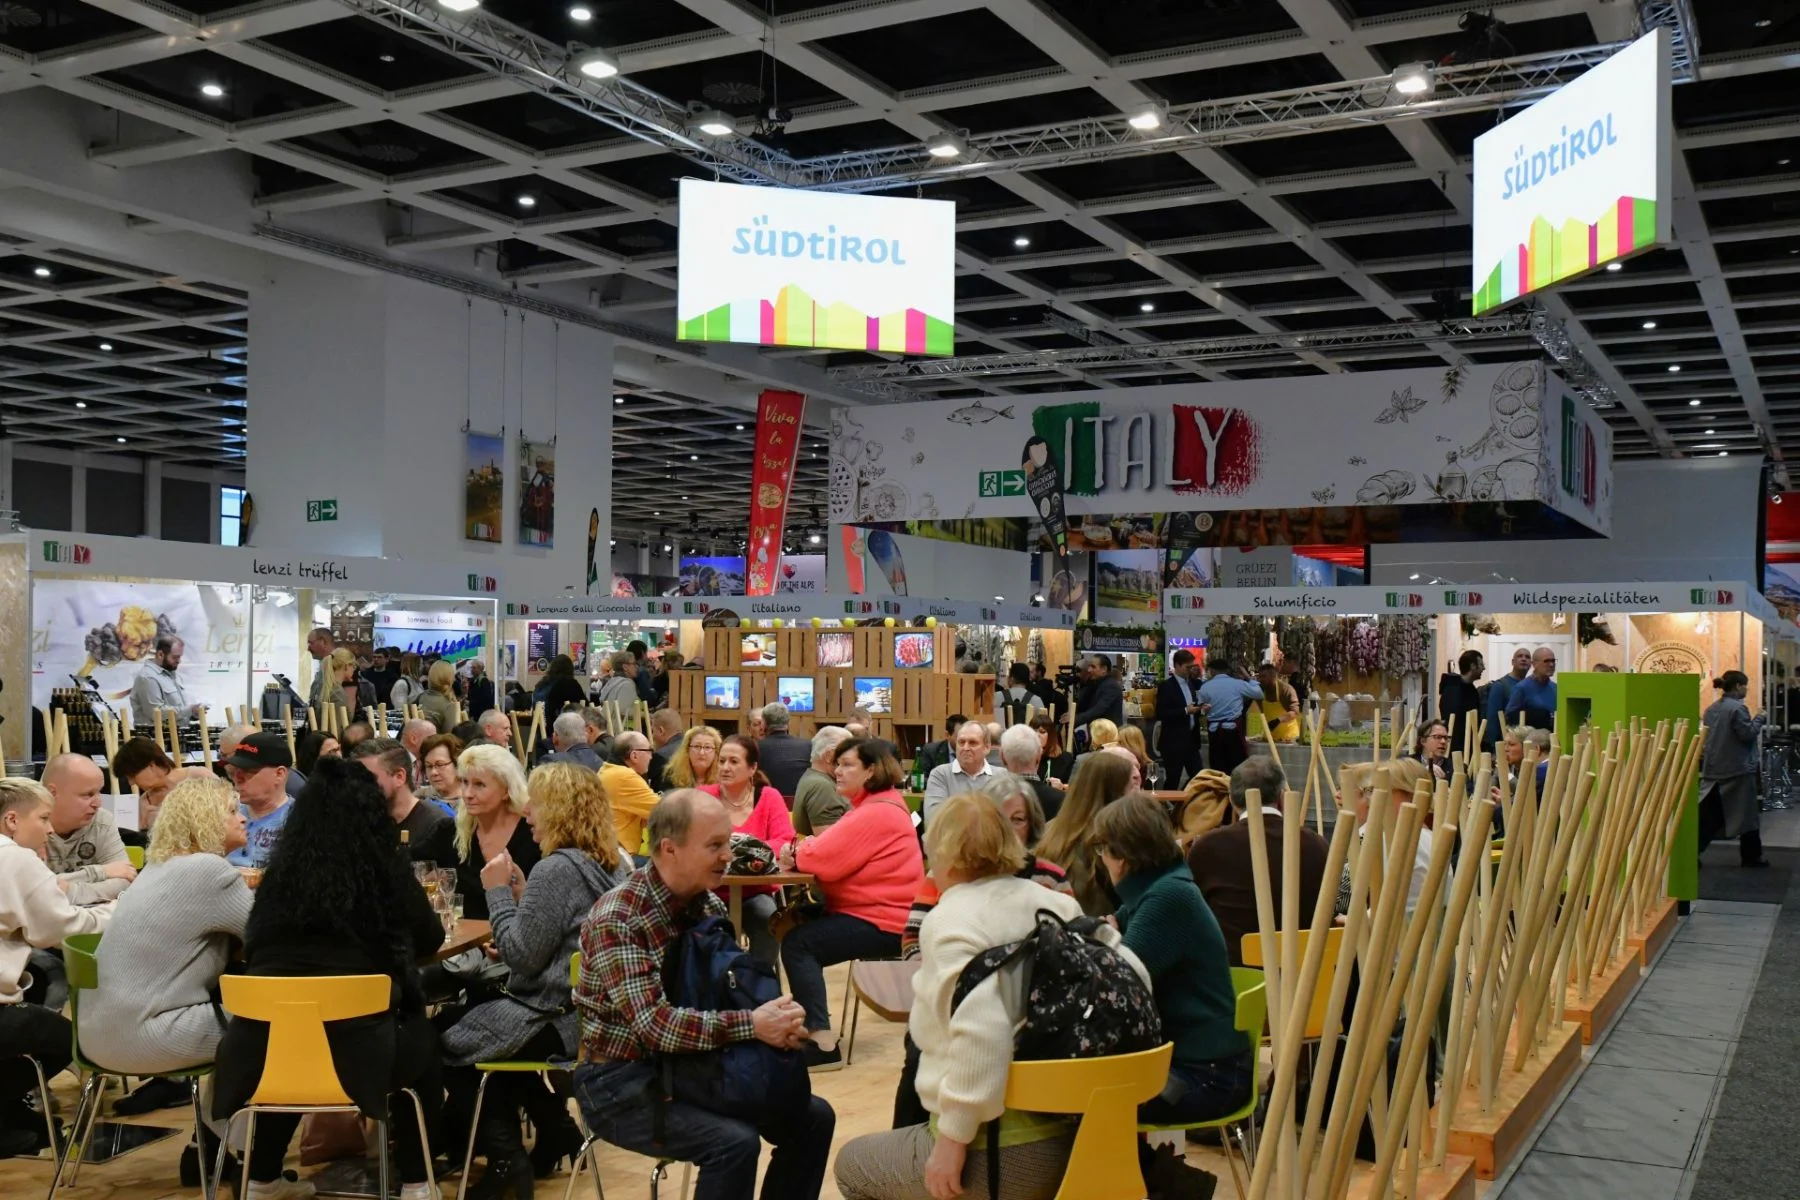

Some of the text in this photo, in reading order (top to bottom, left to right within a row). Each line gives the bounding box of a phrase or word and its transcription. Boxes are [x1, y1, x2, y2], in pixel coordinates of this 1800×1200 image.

[764, 403, 798, 425] Viva
[1063, 407, 1237, 493] ITALY
[1562, 400, 1596, 509] ITALY
[45, 541, 91, 565] ITALY
[253, 559, 349, 583] lenzi trüffel
[468, 573, 497, 592] ITALY
[801, 580, 815, 590] ALPS
[1236, 577, 1277, 588] BERLIN
[1171, 595, 1204, 610] ITALY
[1253, 595, 1337, 609] Salumificio
[1386, 592, 1423, 608] ITALY
[1445, 590, 1482, 607] ITALY
[1512, 590, 1660, 611] Wildspezialitäten
[1690, 588, 1733, 606] ITALY
[536, 603, 642, 614] Lorenzo Galli Cioccolato
